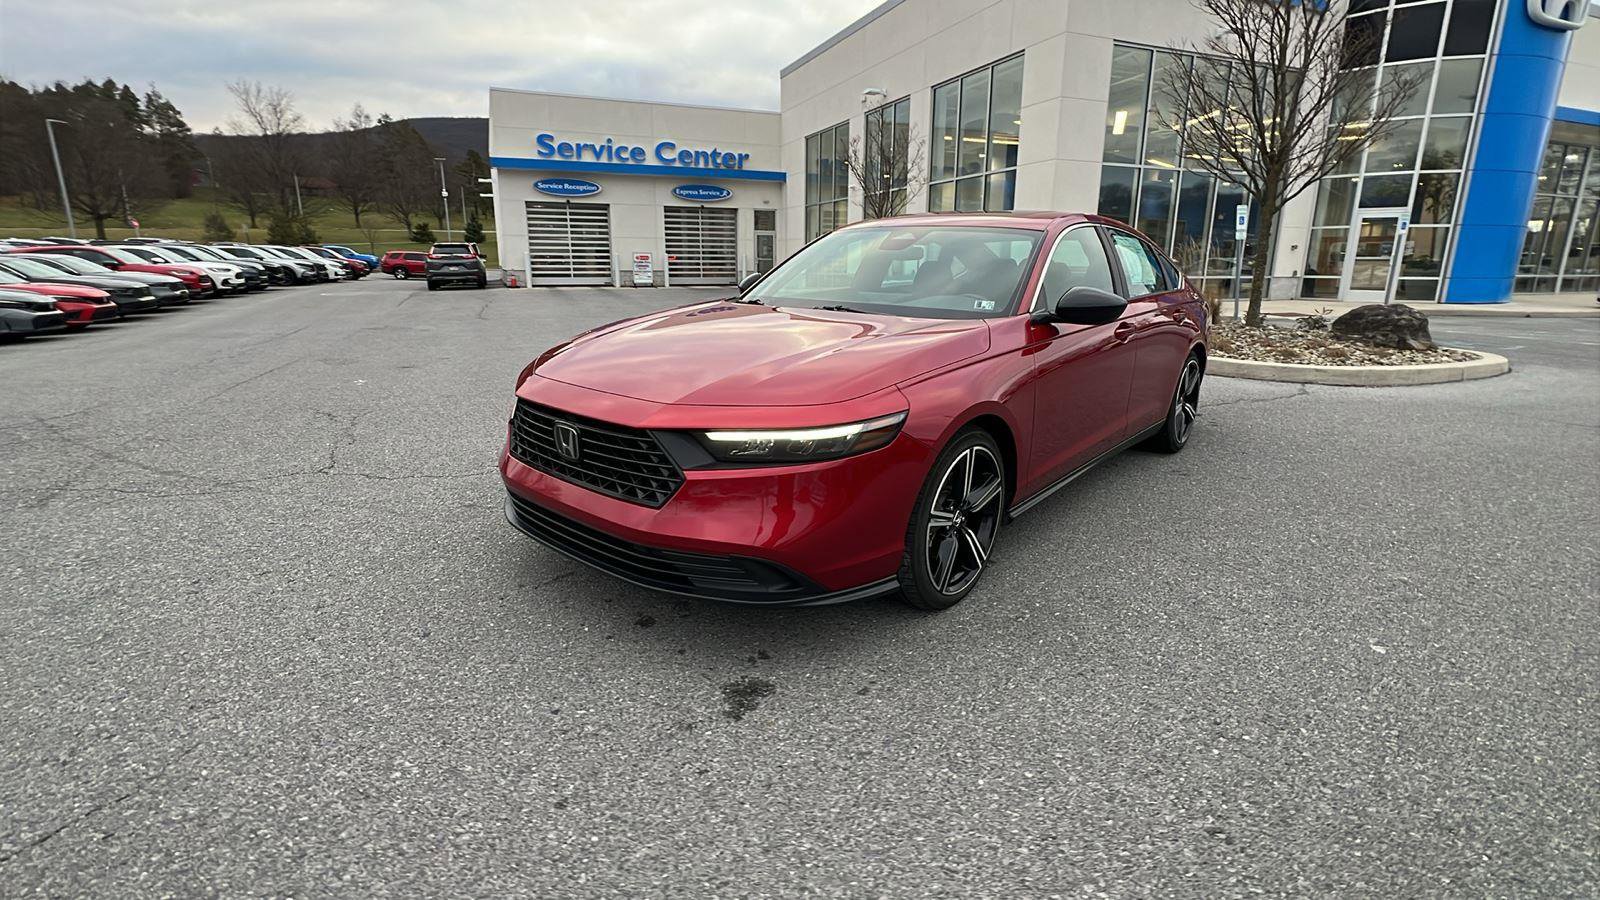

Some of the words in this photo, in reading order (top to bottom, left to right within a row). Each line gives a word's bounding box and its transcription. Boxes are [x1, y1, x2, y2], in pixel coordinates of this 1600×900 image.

[536, 133, 646, 162] Service
[655, 141, 750, 169] Center
[537, 182, 563, 190] Service
[564, 183, 598, 192] Reception
[675, 188, 698, 196] Express
